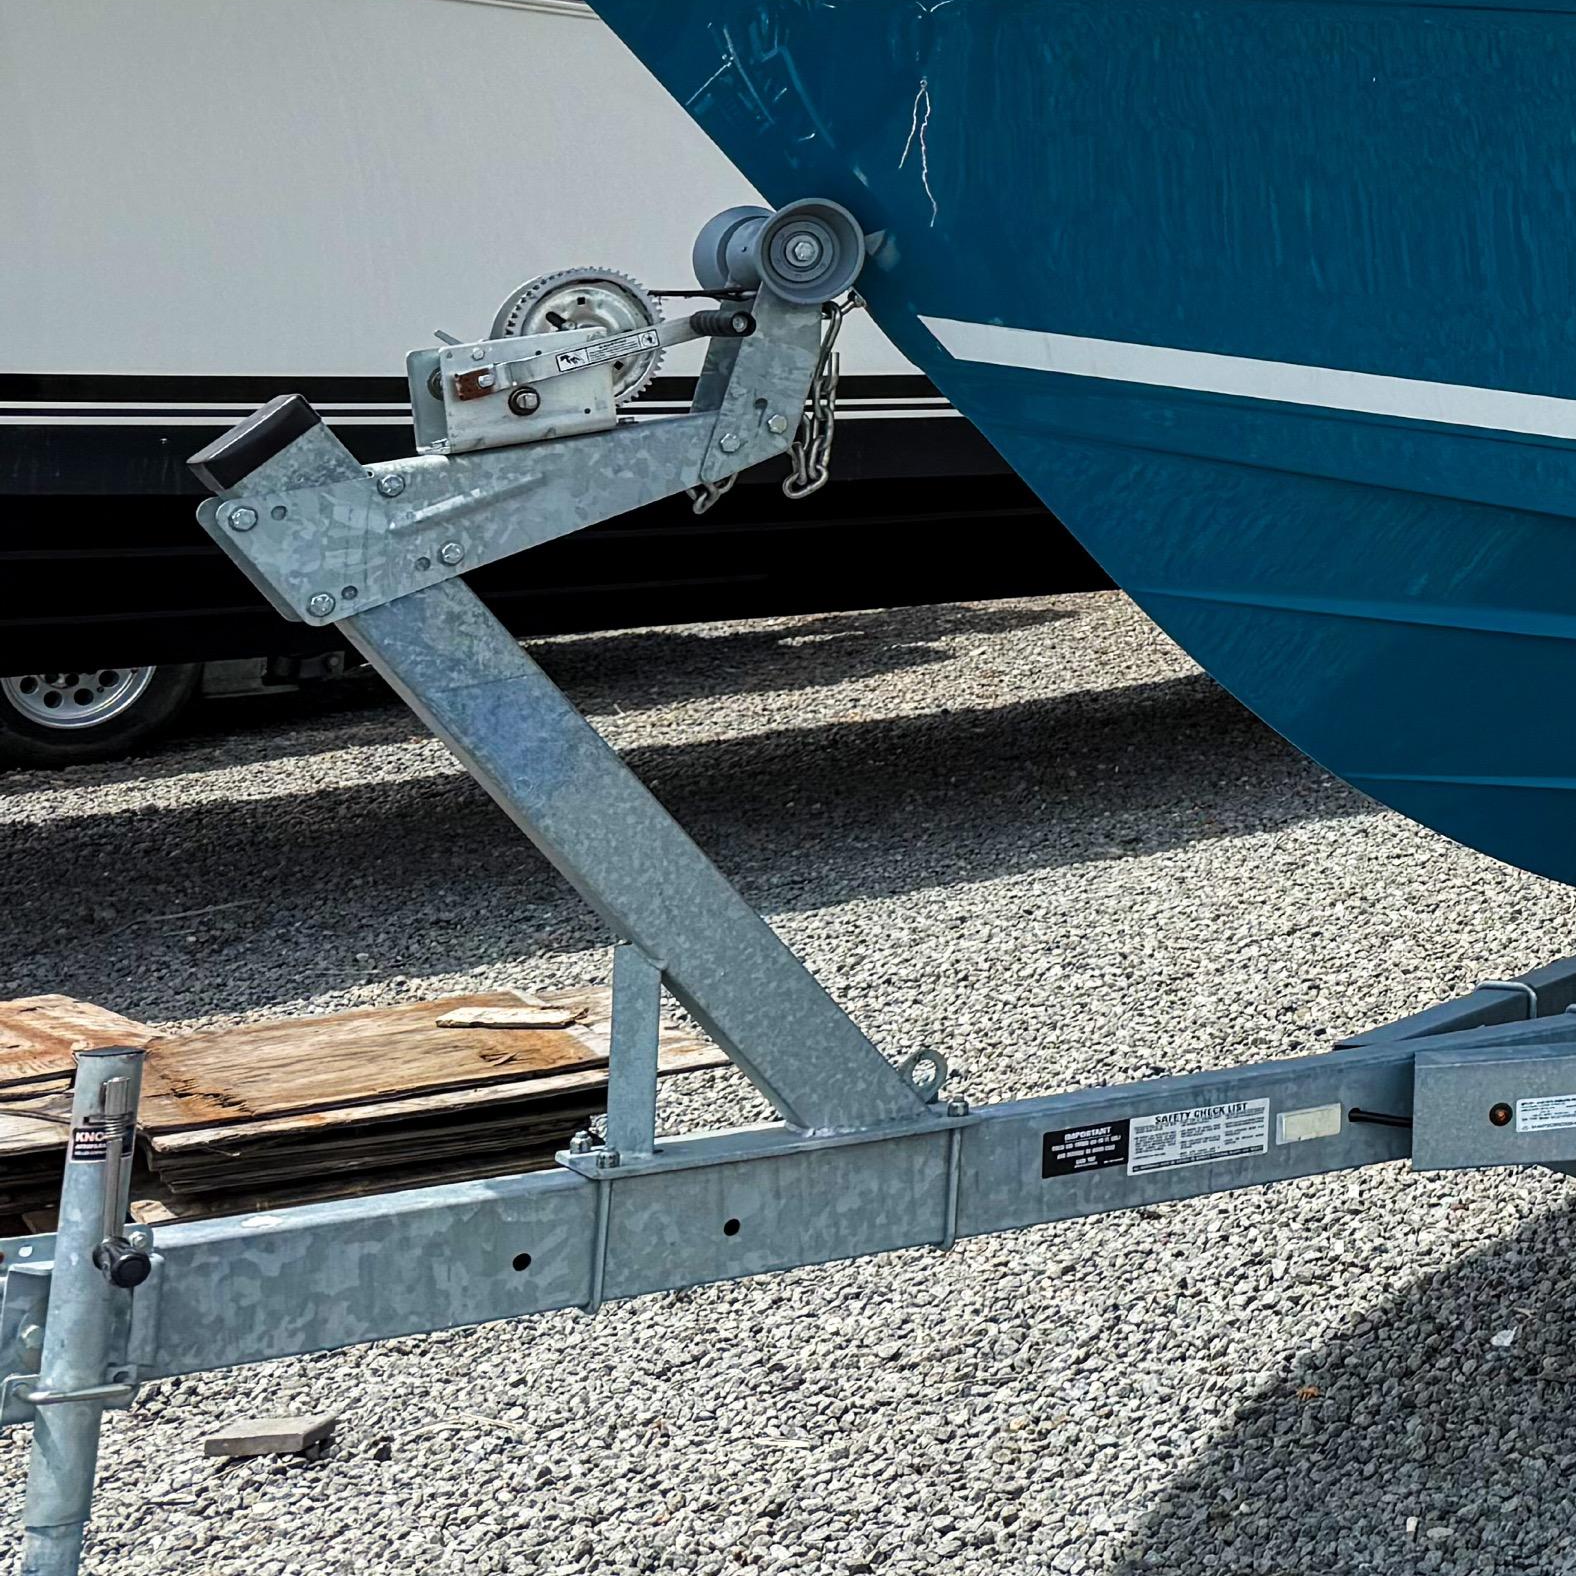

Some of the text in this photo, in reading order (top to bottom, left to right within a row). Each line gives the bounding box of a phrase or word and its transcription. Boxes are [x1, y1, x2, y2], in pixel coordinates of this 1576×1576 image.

[1155, 1102, 1248, 1124] SAFETY CHECK LIST
